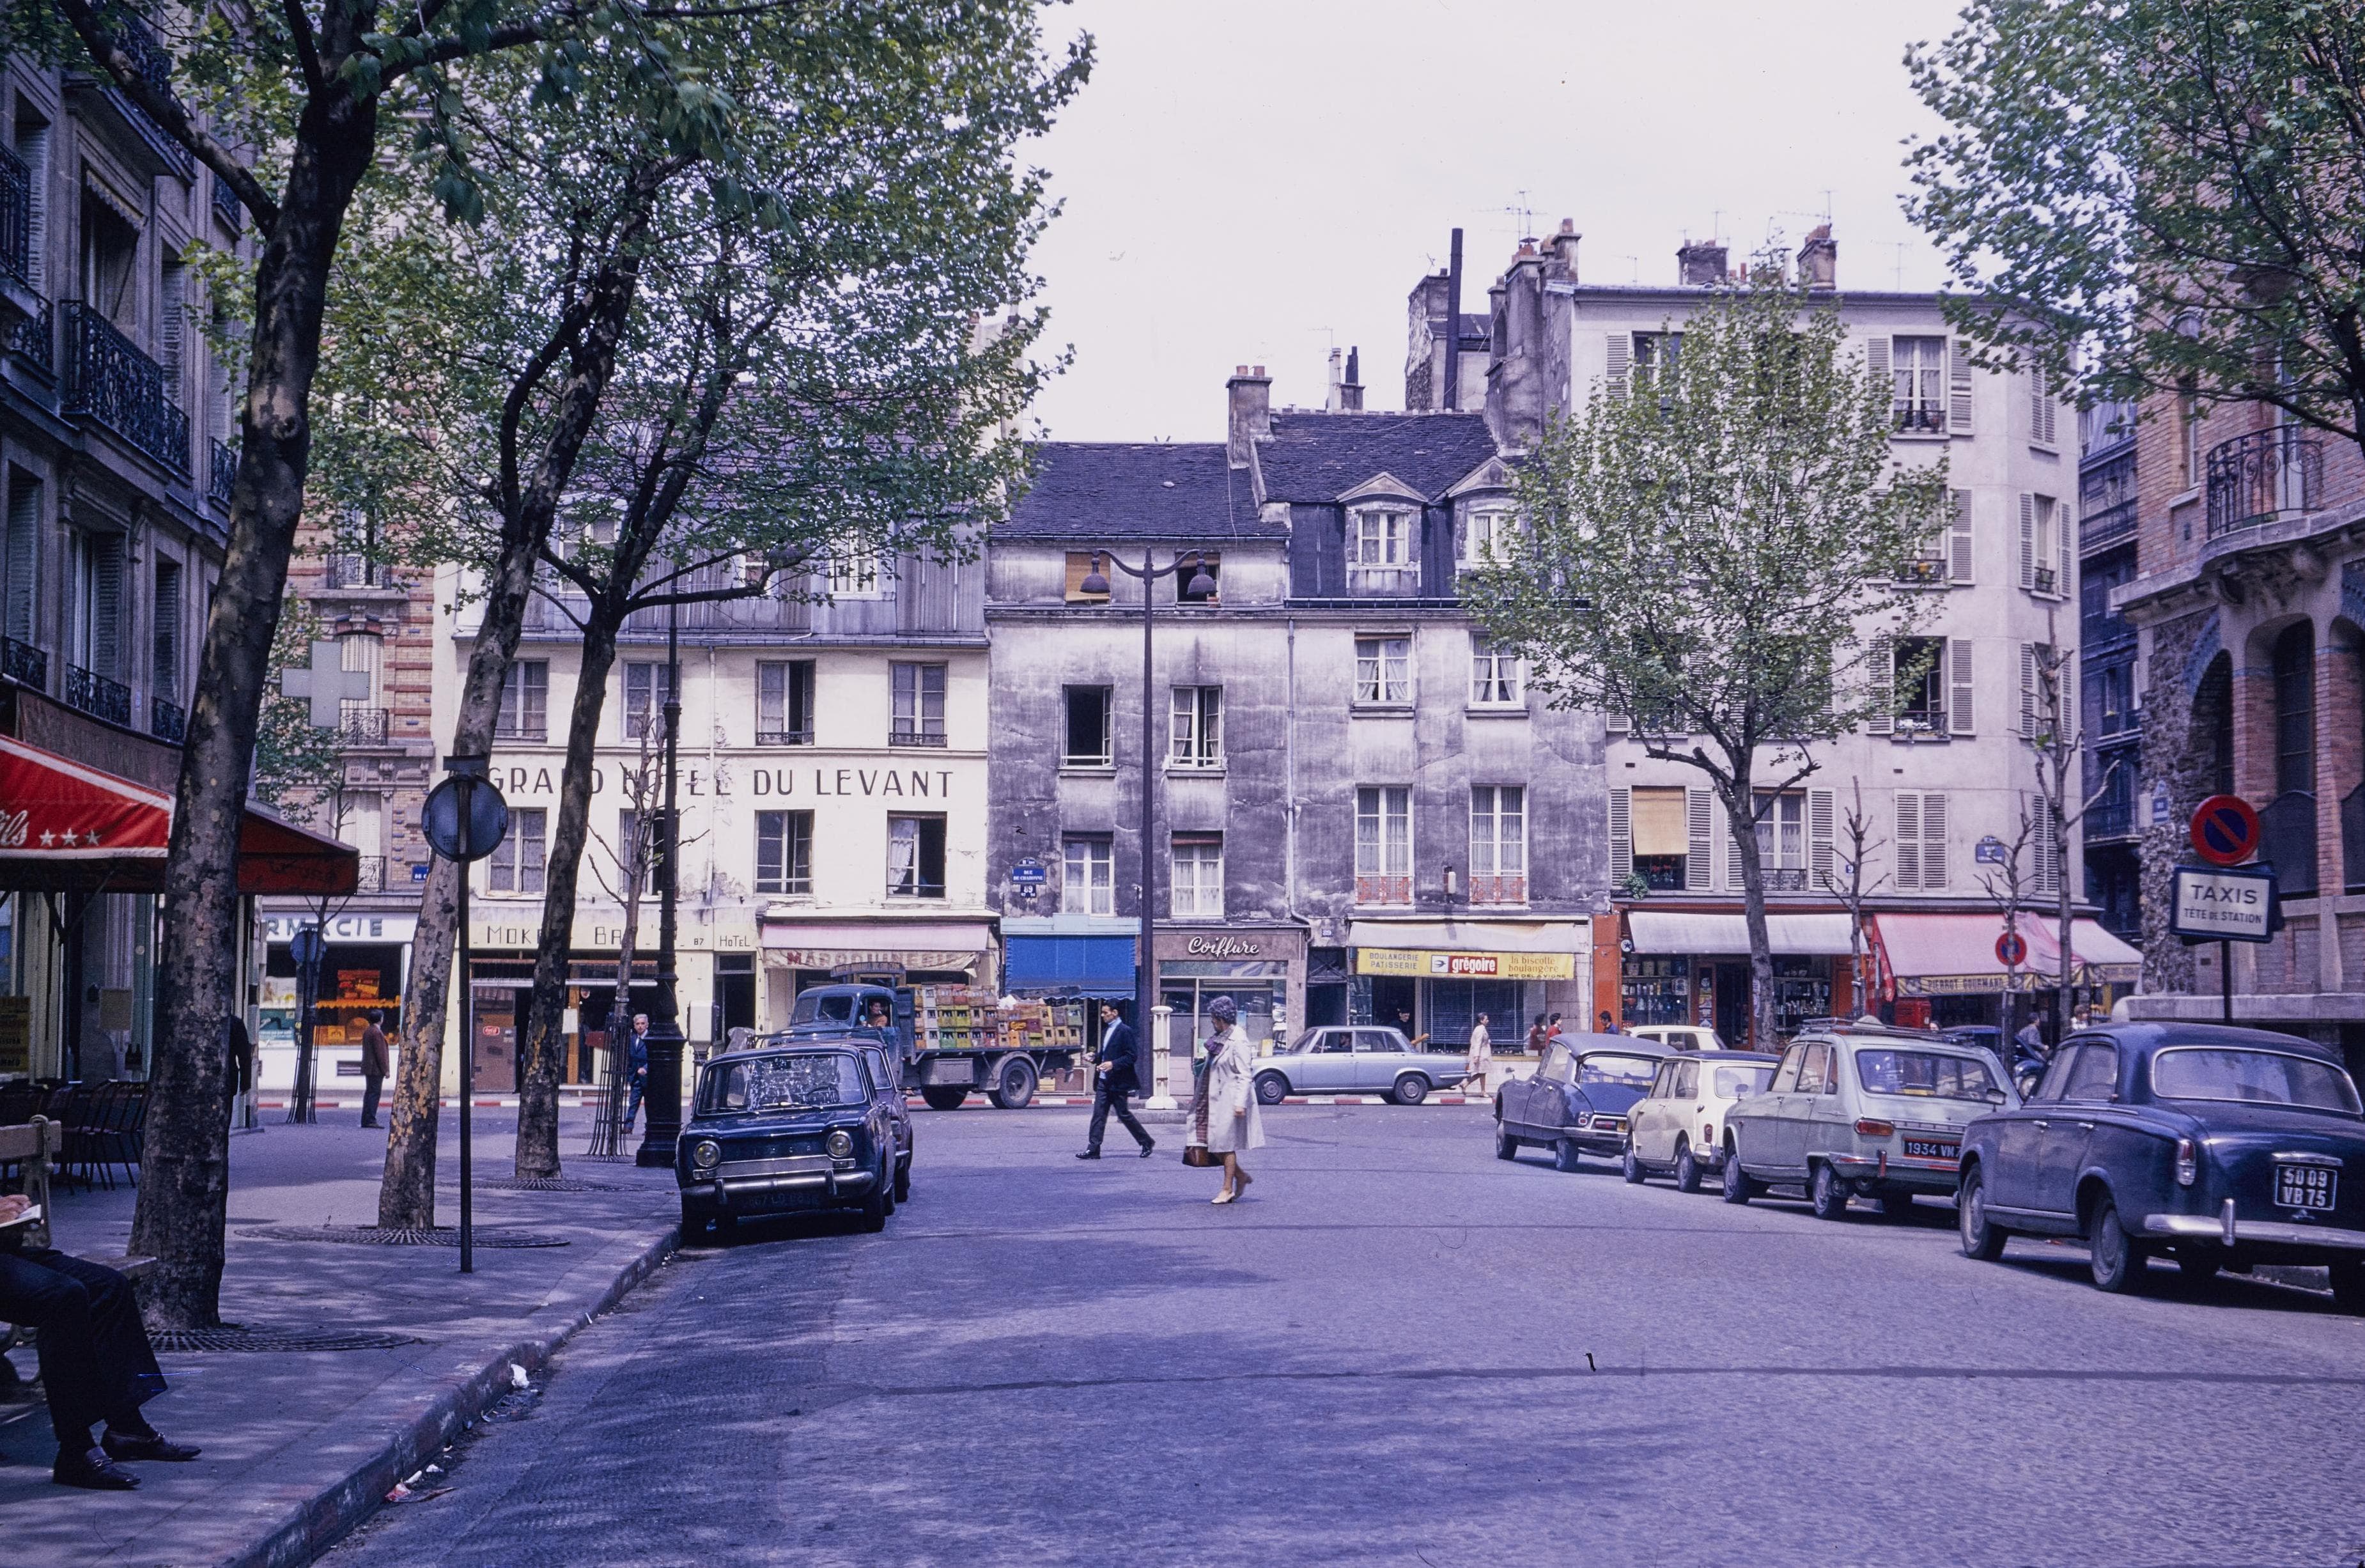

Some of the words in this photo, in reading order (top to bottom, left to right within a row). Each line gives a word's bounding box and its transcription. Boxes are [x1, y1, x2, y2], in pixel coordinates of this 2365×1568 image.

[488, 767, 603, 794] GRAD
[754, 769, 792, 795] DU
[816, 769, 954, 797] LEVANT
[1847, 865, 1854, 873] 9
[2191, 885, 2258, 904] TAXIS
[2221, 912, 2262, 924] STATION
[267, 917, 383, 937] RMCIE
[594, 926, 622, 945] BA
[694, 938, 704, 946] 87
[1188, 936, 1259, 958] Coiffure
[1369, 952, 1418, 961] BOULANGERIE
[1521, 956, 1555, 965] biscotte
[1370, 961, 1418, 969] PATISSERIE
[1452, 957, 1496, 974] grégoire
[1908, 1142, 1937, 1156] 1934
